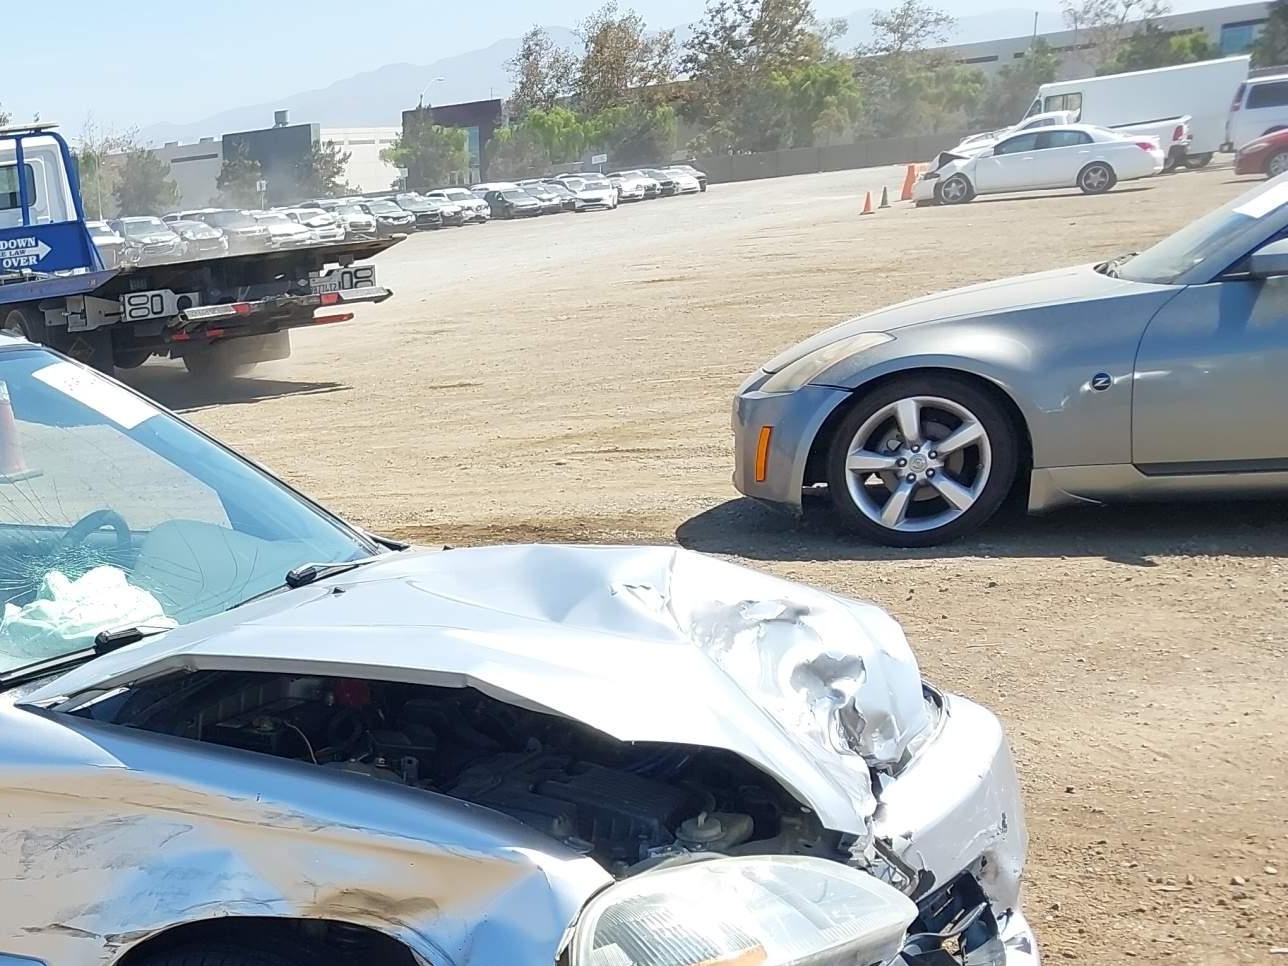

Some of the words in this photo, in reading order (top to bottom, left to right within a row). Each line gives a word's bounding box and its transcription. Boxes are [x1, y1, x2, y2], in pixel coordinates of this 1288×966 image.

[0, 237, 36, 251] DOWN
[9, 249, 27, 257] LAW
[2, 256, 38, 269] OVER
